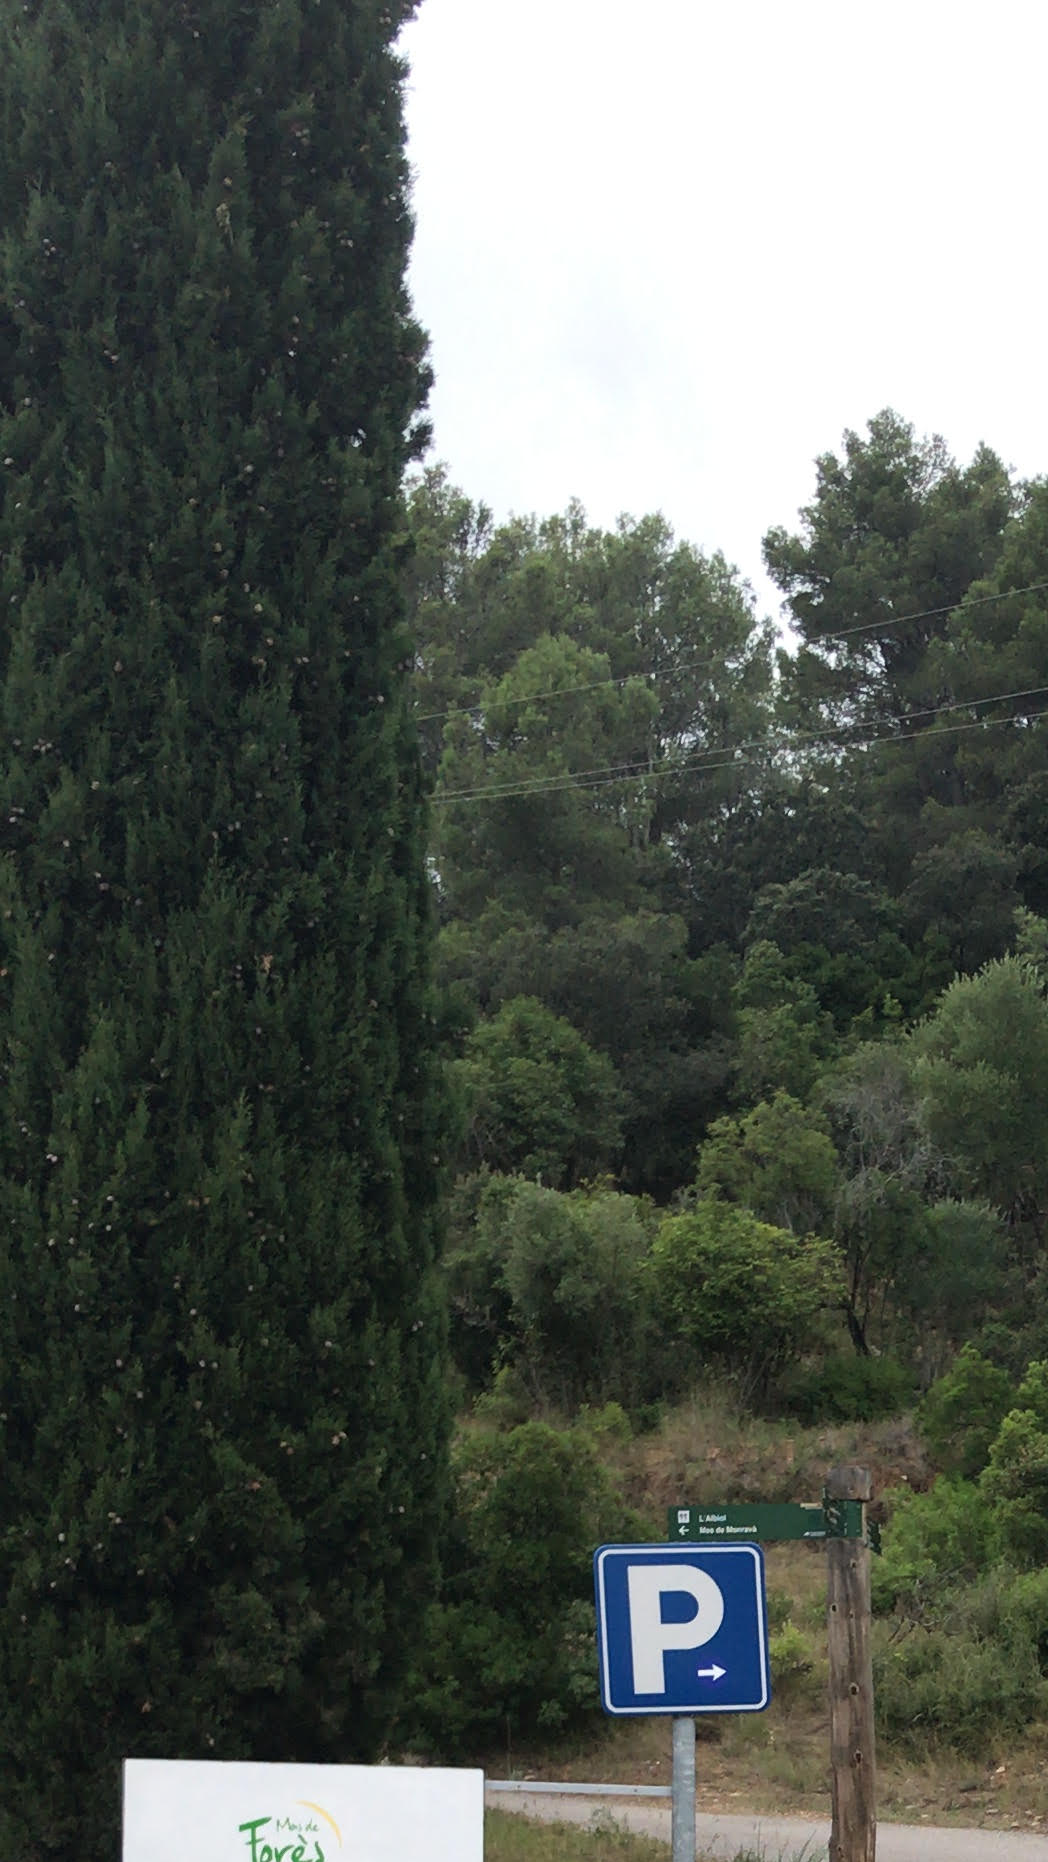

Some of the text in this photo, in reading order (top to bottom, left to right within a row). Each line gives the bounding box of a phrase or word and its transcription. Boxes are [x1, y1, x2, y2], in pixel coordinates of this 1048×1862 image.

[627, 1564, 725, 1695] P
[276, 1816, 320, 1832] Mas de
